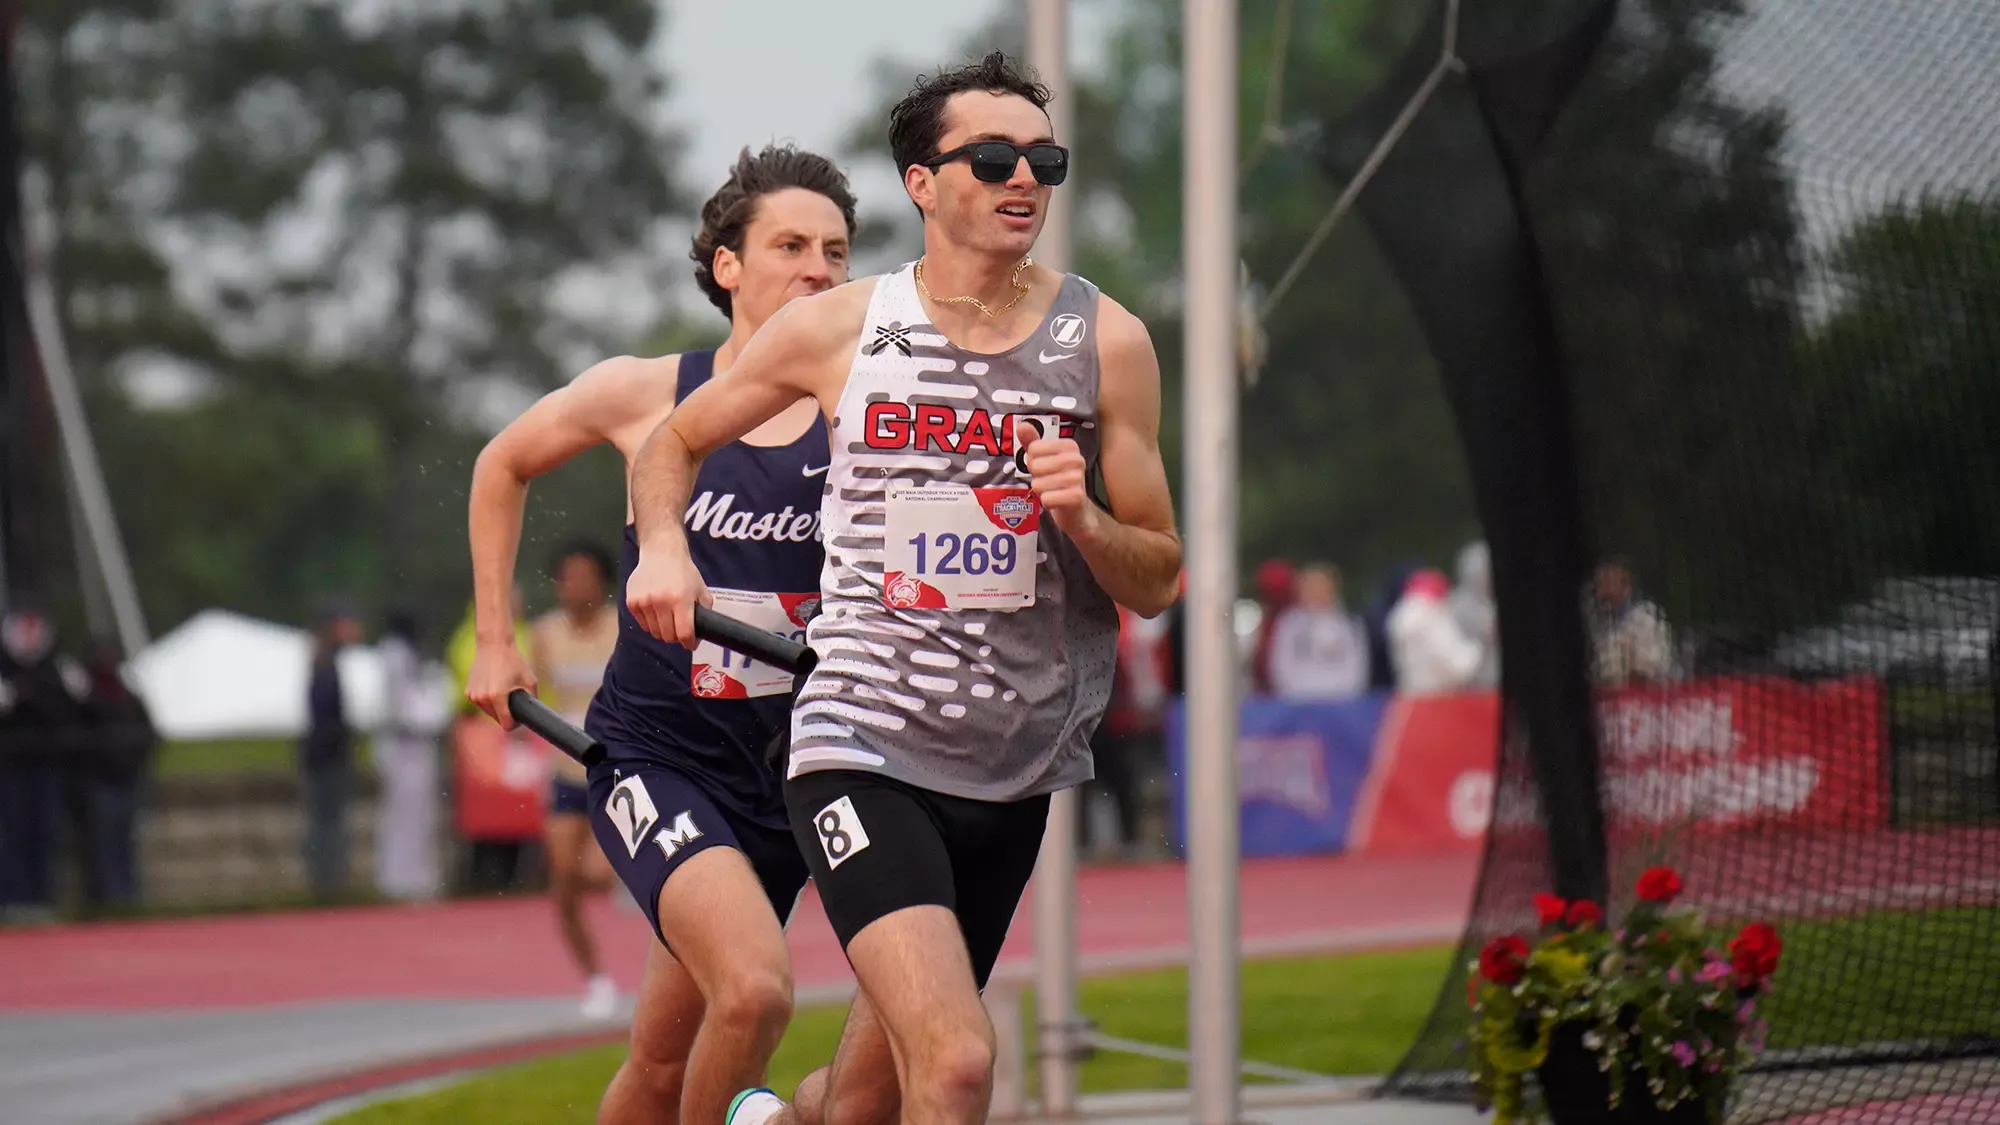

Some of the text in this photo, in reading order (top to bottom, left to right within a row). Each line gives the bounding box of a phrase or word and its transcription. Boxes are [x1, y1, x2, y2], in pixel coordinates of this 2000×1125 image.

[1054, 317, 1083, 344] Z
[909, 533, 1016, 575] 1269
[612, 786, 650, 845] 2
[652, 810, 704, 861] M
[818, 809, 852, 860] 8
